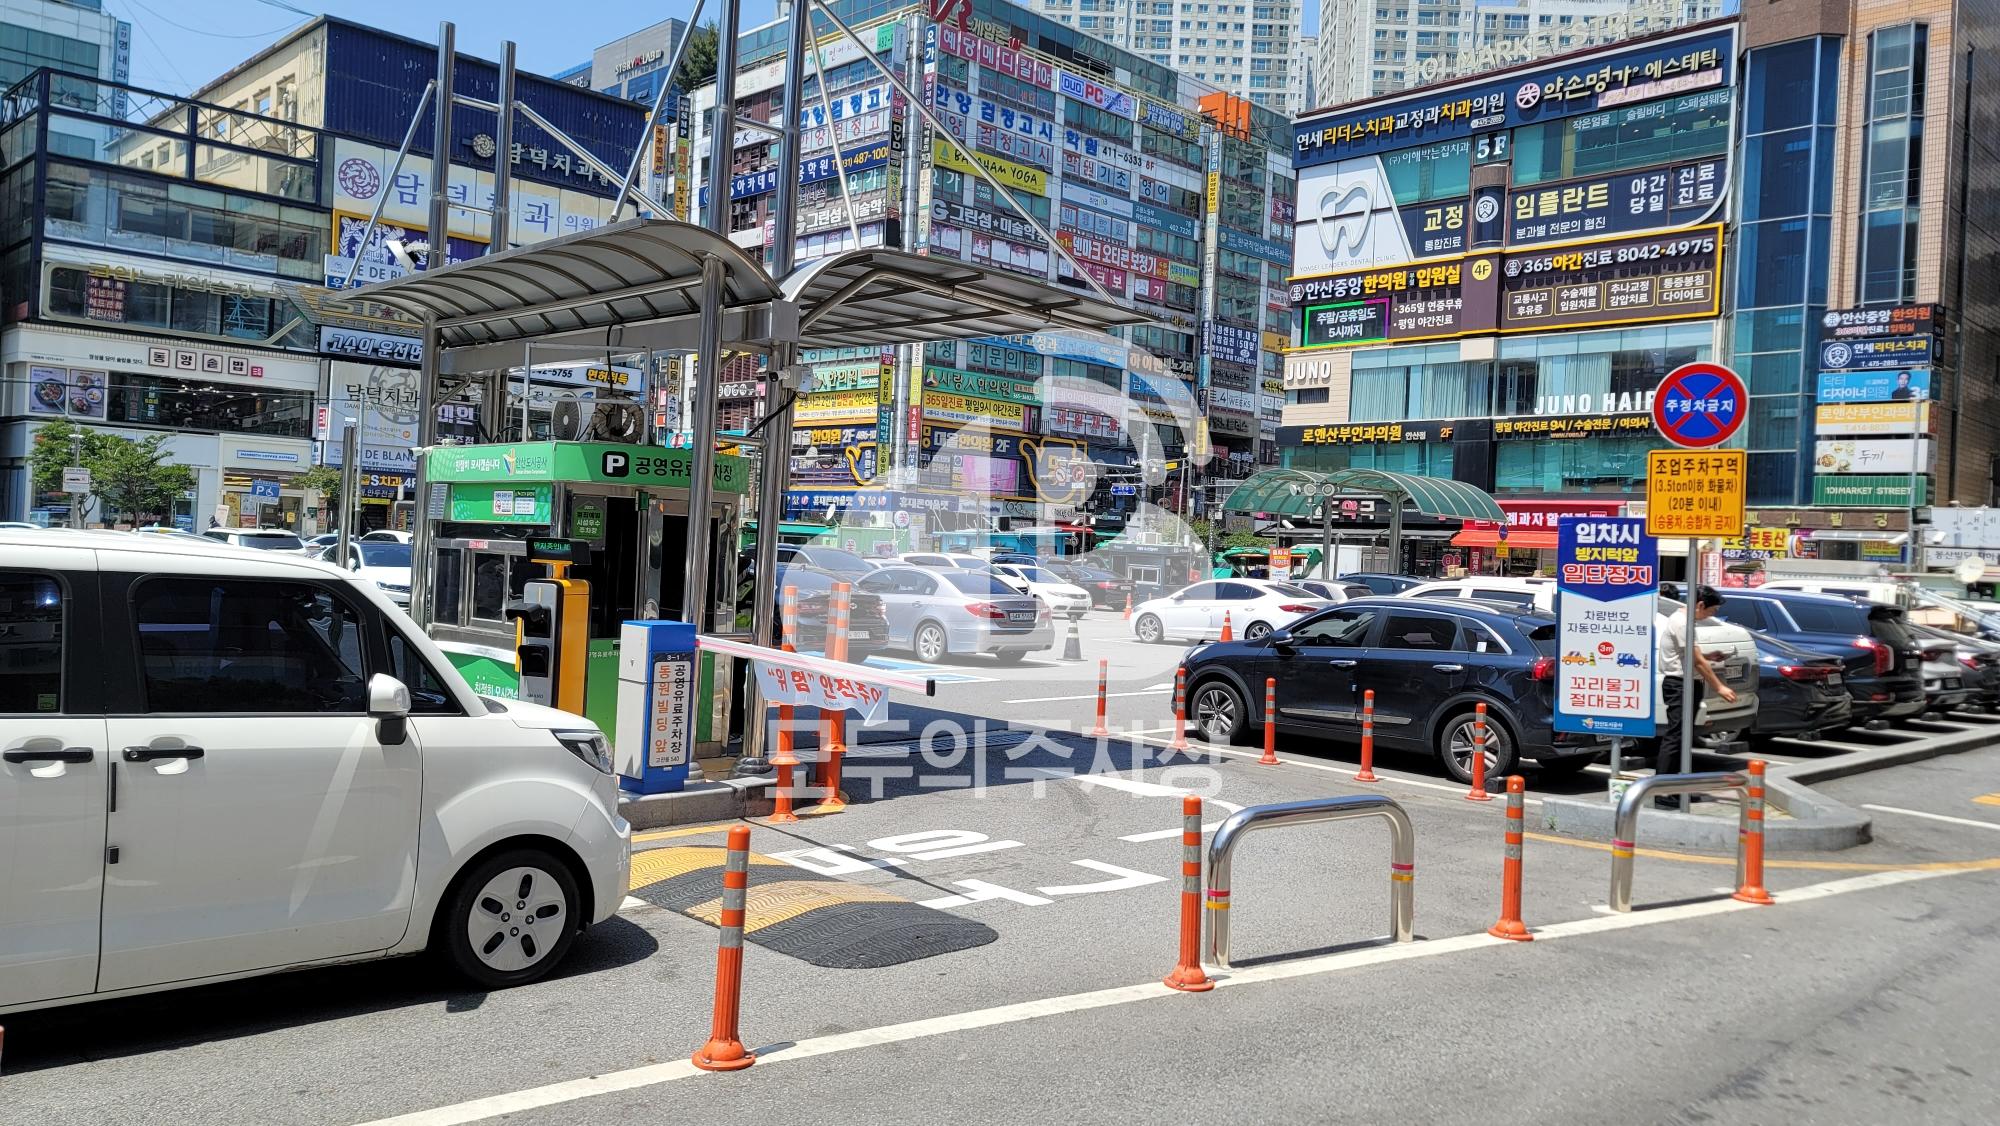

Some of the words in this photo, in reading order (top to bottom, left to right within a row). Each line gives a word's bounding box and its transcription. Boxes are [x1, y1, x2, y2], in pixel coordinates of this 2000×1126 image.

[926, 31, 935, 61] 요가
[1456, 28, 1567, 78] MARKET
[1038, 62, 1051, 84] 10F
[1543, 64, 1633, 100] 약손명가
[1645, 47, 1717, 79] 에스테틱
[1064, 78, 1083, 94] DUO
[1085, 83, 1104, 104] PC
[1678, 91, 1729, 111] 스페셜웨딩
[936, 84, 972, 115] 한양
[980, 100, 1053, 142] 검정고시
[1066, 129, 1098, 157] 학원
[1297, 91, 1505, 151] 연세리더스치과교정과치과의원
[1626, 103, 1666, 121] 슬림바디
[1572, 114, 1611, 130] 작은얼굴
[892, 124, 902, 150] DVD
[981, 124, 1051, 160] 검정고시
[1477, 135, 1507, 159] 5F
[1389, 156, 1401, 167] (구)
[848, 169, 879, 191] 요가
[1011, 166, 1038, 186] YOGA
[1100, 165, 1127, 188] 기초
[1143, 178, 1168, 201] 영어
[1631, 173, 1667, 195] 야간
[1679, 163, 1716, 186] 진료
[1515, 182, 1609, 220] 임플란트
[1629, 194, 1665, 216] 당일
[1678, 182, 1715, 206] 진료
[563, 214, 594, 232] 의원
[807, 207, 842, 228] 그린섬
[950, 203, 992, 229] 그린섬
[1423, 204, 1464, 233] 교정
[1516, 224, 1547, 240] 분과별
[1549, 220, 1582, 236] 전문의
[1584, 216, 1607, 231] 협진
[1072, 232, 1101, 260] 덴마크
[1102, 244, 1130, 268] 오티콘
[1424, 235, 1462, 252] 통합진료
[1321, 262, 1350, 270] LEADERS
[1350, 258, 1374, 266] DENTAL
[1375, 254, 1397, 262] CLINIC
[1474, 264, 1489, 276] 4F
[1523, 250, 1614, 274] 365야간진료
[1305, 272, 1407, 300] 안산중앙한의원
[1416, 264, 1461, 289] 입원실
[1611, 280, 1650, 294] 추나교정
[1663, 274, 1706, 289] 통증봉침
[1513, 292, 1549, 305] 교통사고
[1560, 286, 1598, 299] 수술재활
[1610, 294, 1649, 307] 감압치료
[1663, 289, 1705, 302] 다이어트
[1399, 302, 1425, 315] 365일
[1427, 299, 1463, 313] 연중무휴
[1516, 305, 1544, 317] 후유증
[1560, 299, 1597, 312] 입원치료
[1317, 307, 1377, 326] 주말/공휴일도
[1398, 316, 1418, 330] 평일
[1418, 314, 1454, 328] 야간진료
[1841, 306, 1931, 325] 안산중앙한의원
[1328, 323, 1363, 339] 5시까지
[329, 333, 375, 356] 고수의
[1853, 340, 1928, 354] 연세리더스치과
[151, 349, 246, 373] 동양솥밥
[970, 343, 1019, 369] 전문의
[1286, 360, 1331, 381] JUNO
[346, 384, 420, 408] 담덕치과
[668, 385, 679, 395] 2F
[925, 393, 963, 409] 365일진료
[965, 399, 992, 414] 평일9시
[992, 403, 1022, 418] 야간진료
[1228, 396, 1251, 409] WEEKS
[1534, 394, 1592, 415] JUNO
[1666, 398, 1734, 413] 주정차금지
[1055, 410, 1119, 432] 네일재료
[1495, 421, 1512, 433] 평일
[1513, 419, 1550, 432] 야간진료
[1551, 419, 1566, 431] 9시
[1574, 418, 1611, 431] 수술전문
[1619, 417, 1650, 429] 여의사
[842, 428, 856, 443] 2F
[1302, 425, 1402, 443] 로앤산부인과의원
[1440, 427, 1453, 439] 2F
[365, 449, 380, 460] DE
[996, 439, 1011, 453] 2F
[470, 458, 500, 472] 모시겠습니다
[515, 456, 548, 469] 안산도시공사
[606, 454, 625, 474] P
[1858, 449, 1885, 466] 두끼
[1655, 458, 1738, 476] 조업주차구역
[256, 485, 265, 495] P
[1655, 479, 1704, 494] (3.5ton이하
[1707, 479, 1738, 493] 화물차)
[1876, 486, 1913, 495] STREET
[1668, 497, 1694, 511] (20분
[1699, 496, 1722, 511] 이내)
[1715, 515, 1737, 530] 금지)
[1575, 523, 1640, 545] 입차시
[1575, 547, 1639, 563] 방지턱앞
[1563, 563, 1652, 586] 일단정지
[1583, 610, 1630, 622] 차량번호
[1567, 622, 1648, 636] 자동인식시스템
[1599, 644, 1614, 653] 3m
[1569, 675, 1640, 693] 꼬리물기
[656, 665, 672, 732] 동원빌딩
[1569, 693, 1640, 711] 절대금지
[670, 664, 686, 754] 공영유료주차장
[655, 739, 667, 754] 앞
